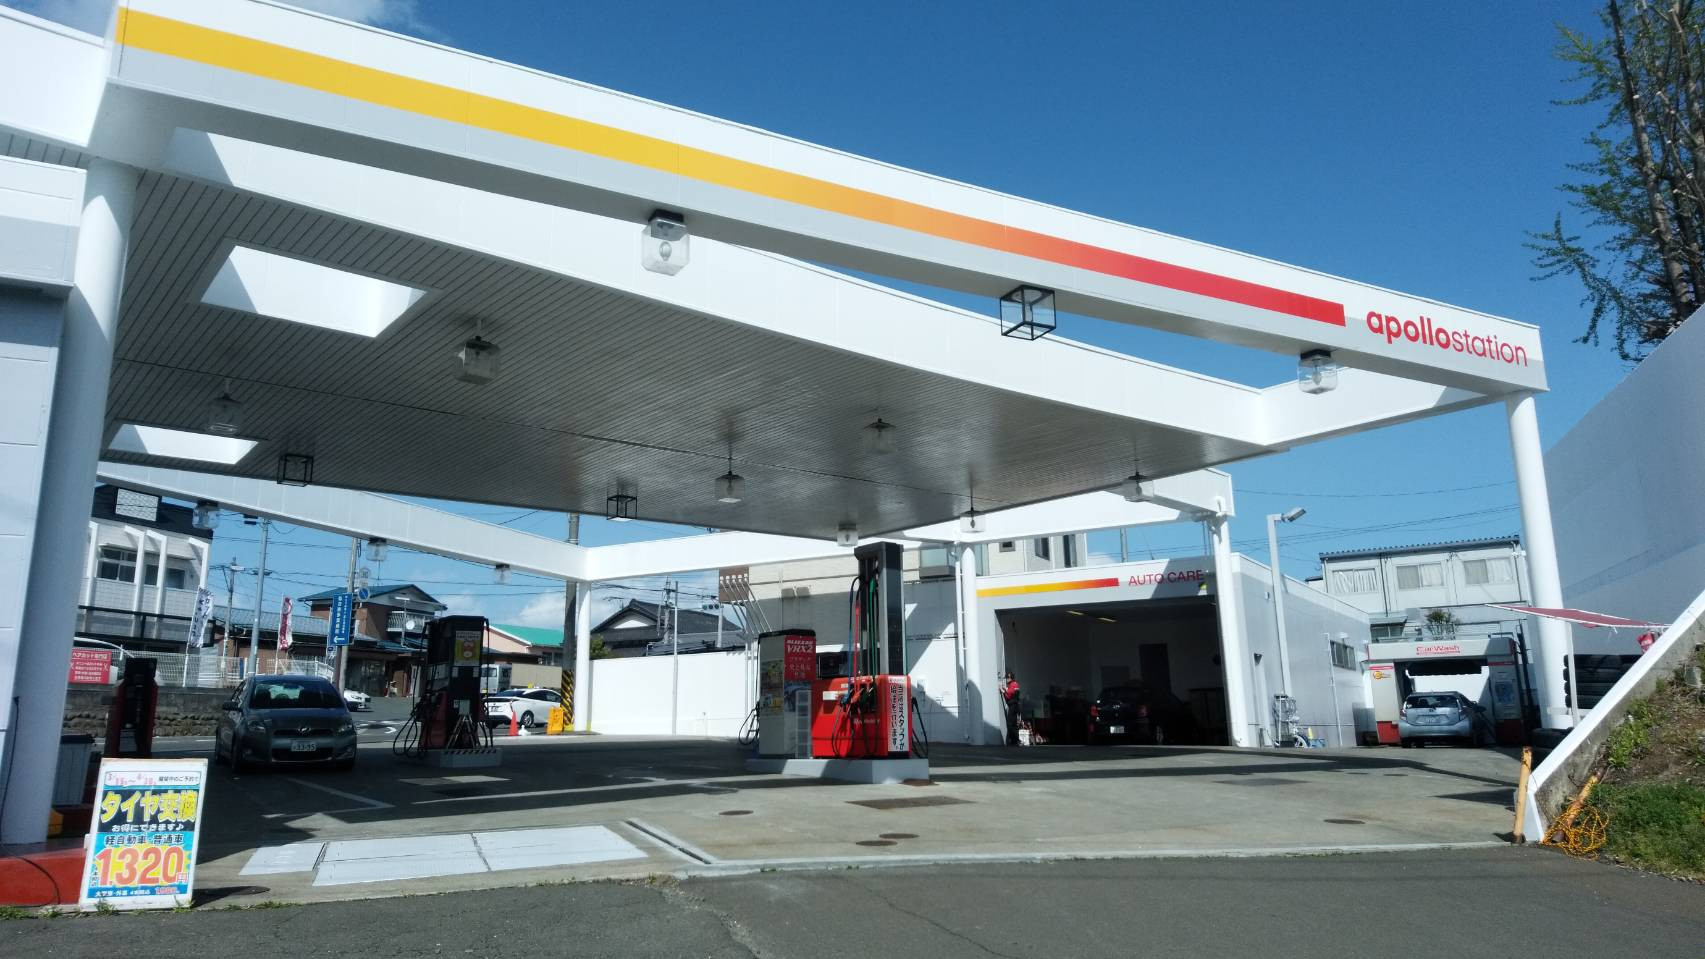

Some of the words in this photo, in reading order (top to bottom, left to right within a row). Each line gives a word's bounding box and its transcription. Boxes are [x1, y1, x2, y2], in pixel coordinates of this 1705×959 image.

[1366, 311, 1528, 367] apollostation
[1128, 573, 1164, 586] AUTO
[1167, 569, 1204, 583] CARE
[787, 644, 813, 653] VRX2
[1433, 644, 1460, 652] Wash
[897, 684, 905, 751] 当店はスタッフが
[101, 790, 198, 823] タイヤ交換
